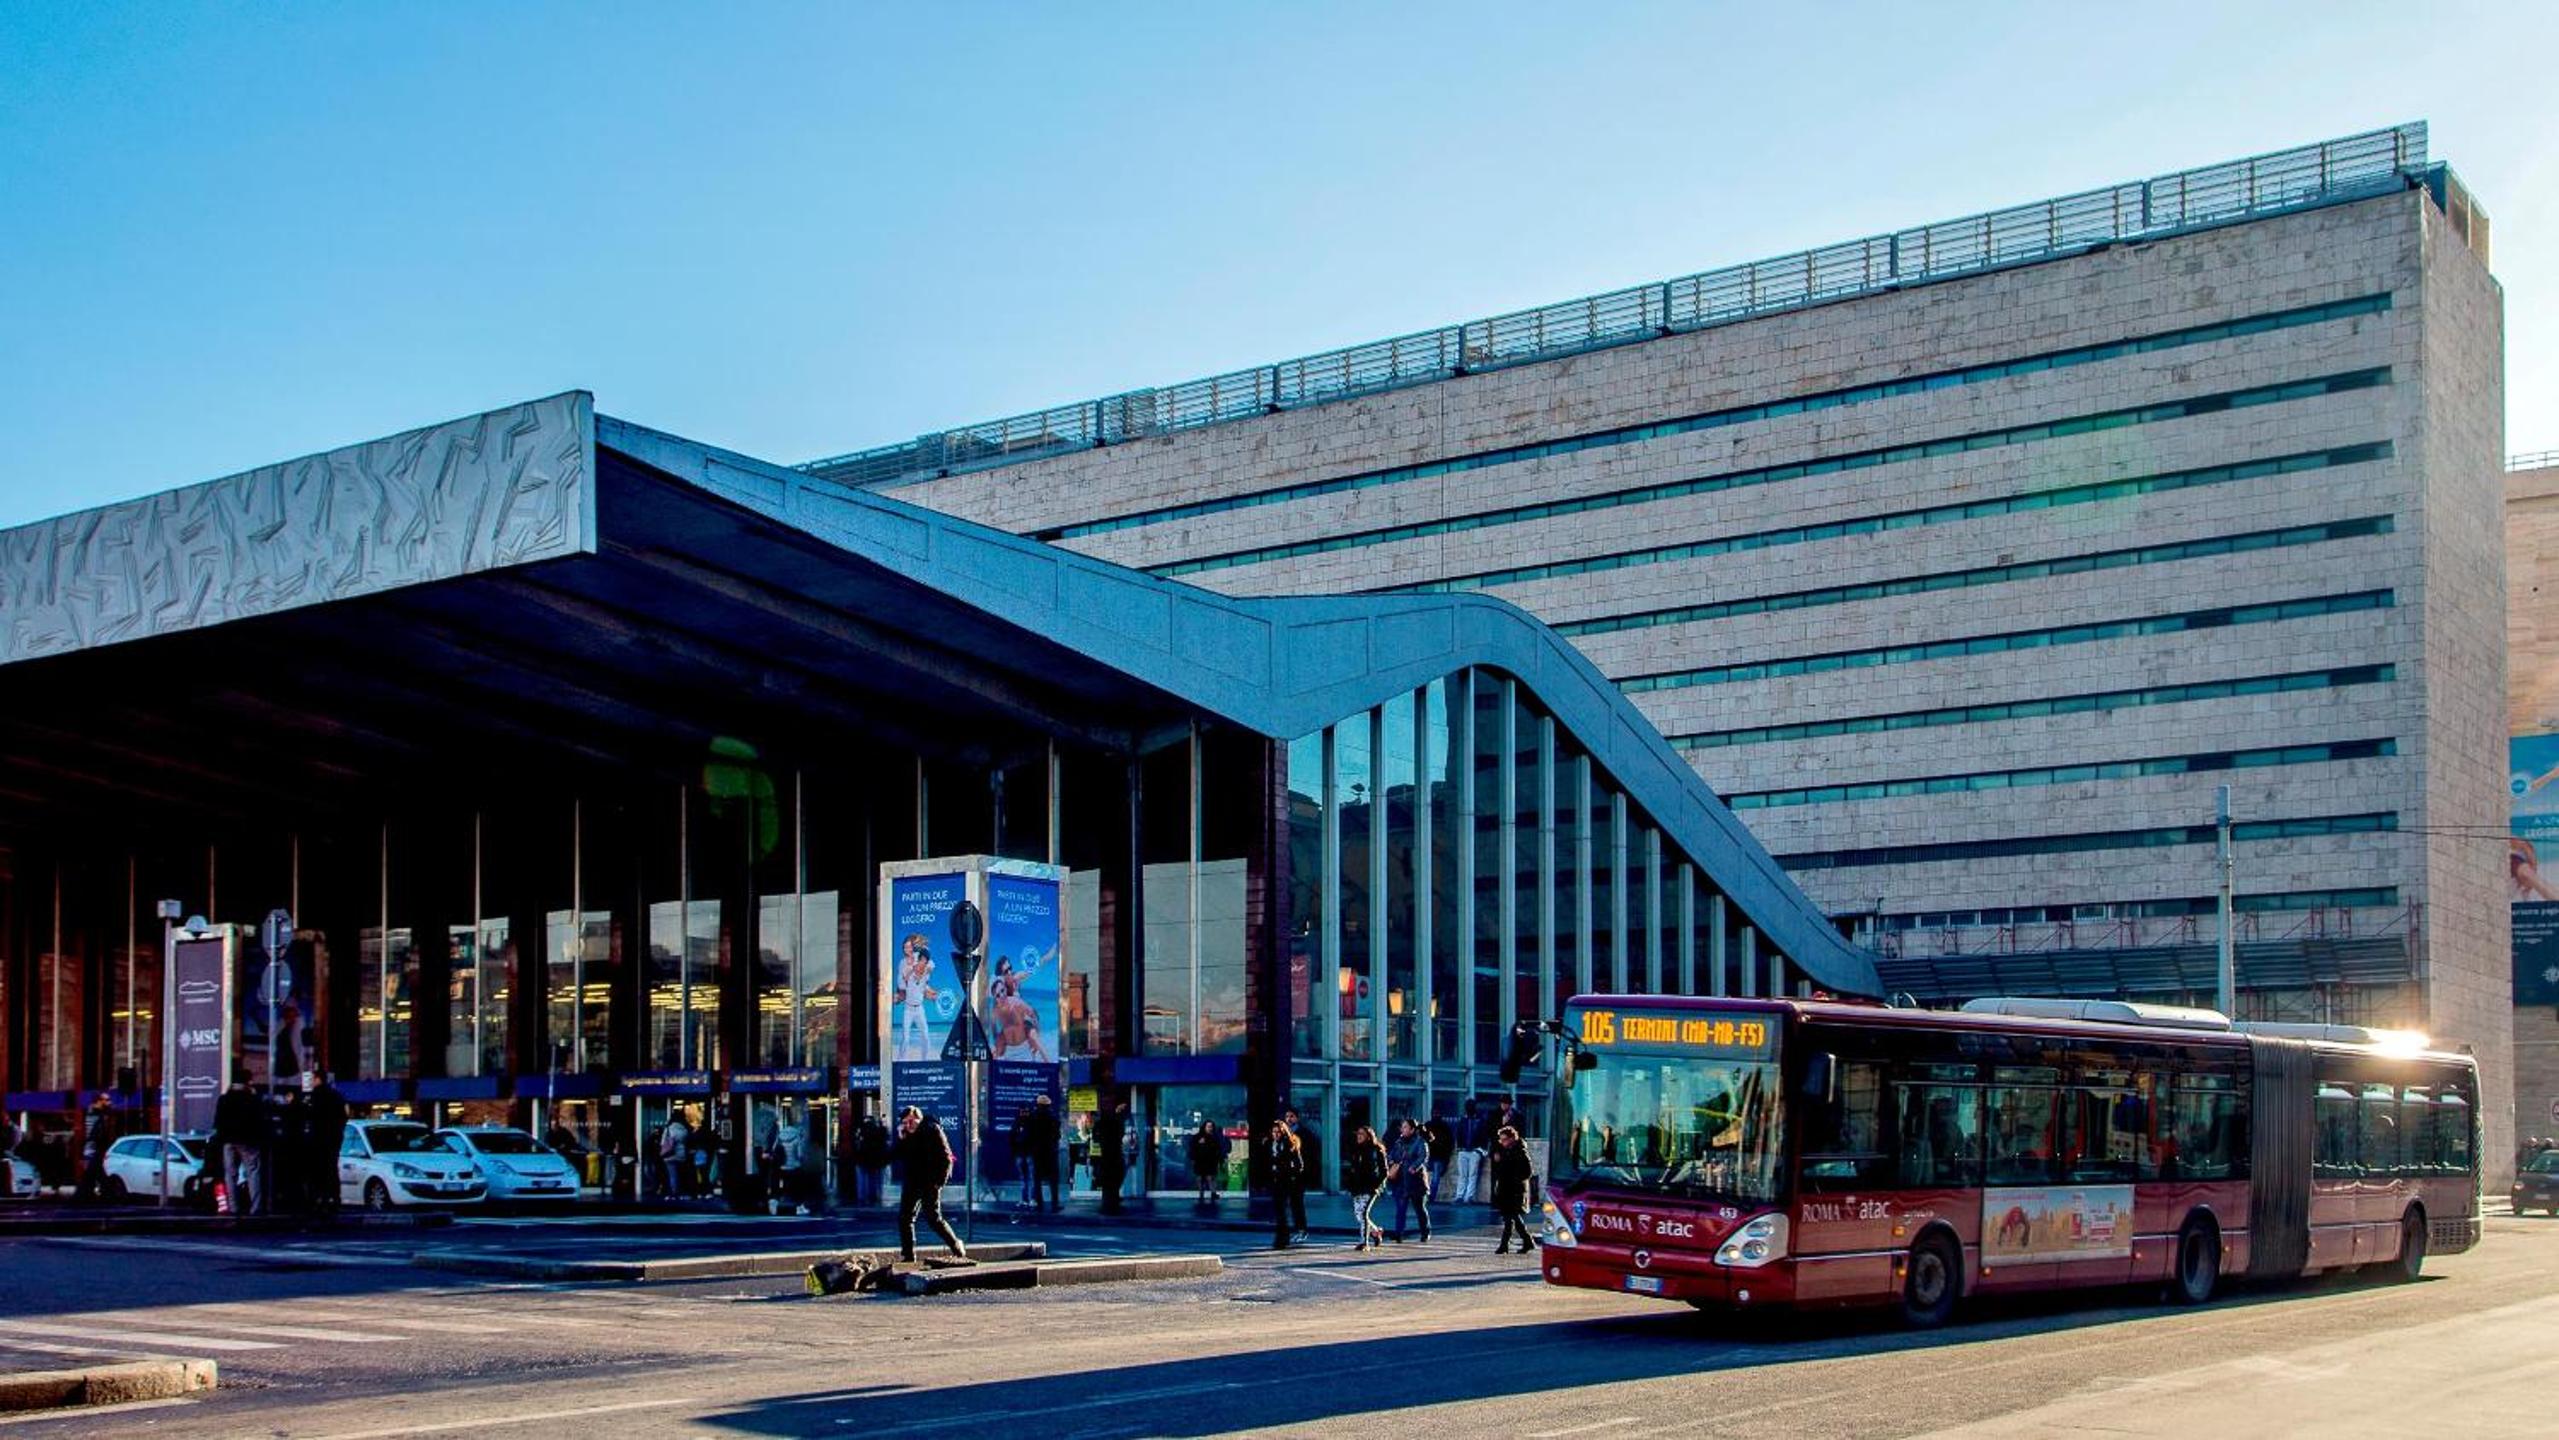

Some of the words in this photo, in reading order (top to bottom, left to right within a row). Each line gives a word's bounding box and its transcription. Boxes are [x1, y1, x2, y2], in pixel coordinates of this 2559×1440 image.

[192, 1029, 220, 1045] MSC
[1582, 1011, 1615, 1044] 105
[1622, 1017, 1678, 1042] TERMINI
[1802, 1203, 1840, 1222] ROMA
[1859, 1199, 1891, 1220] atac
[1591, 1214, 1633, 1231] ROMA
[1656, 1219, 1694, 1238] atac
